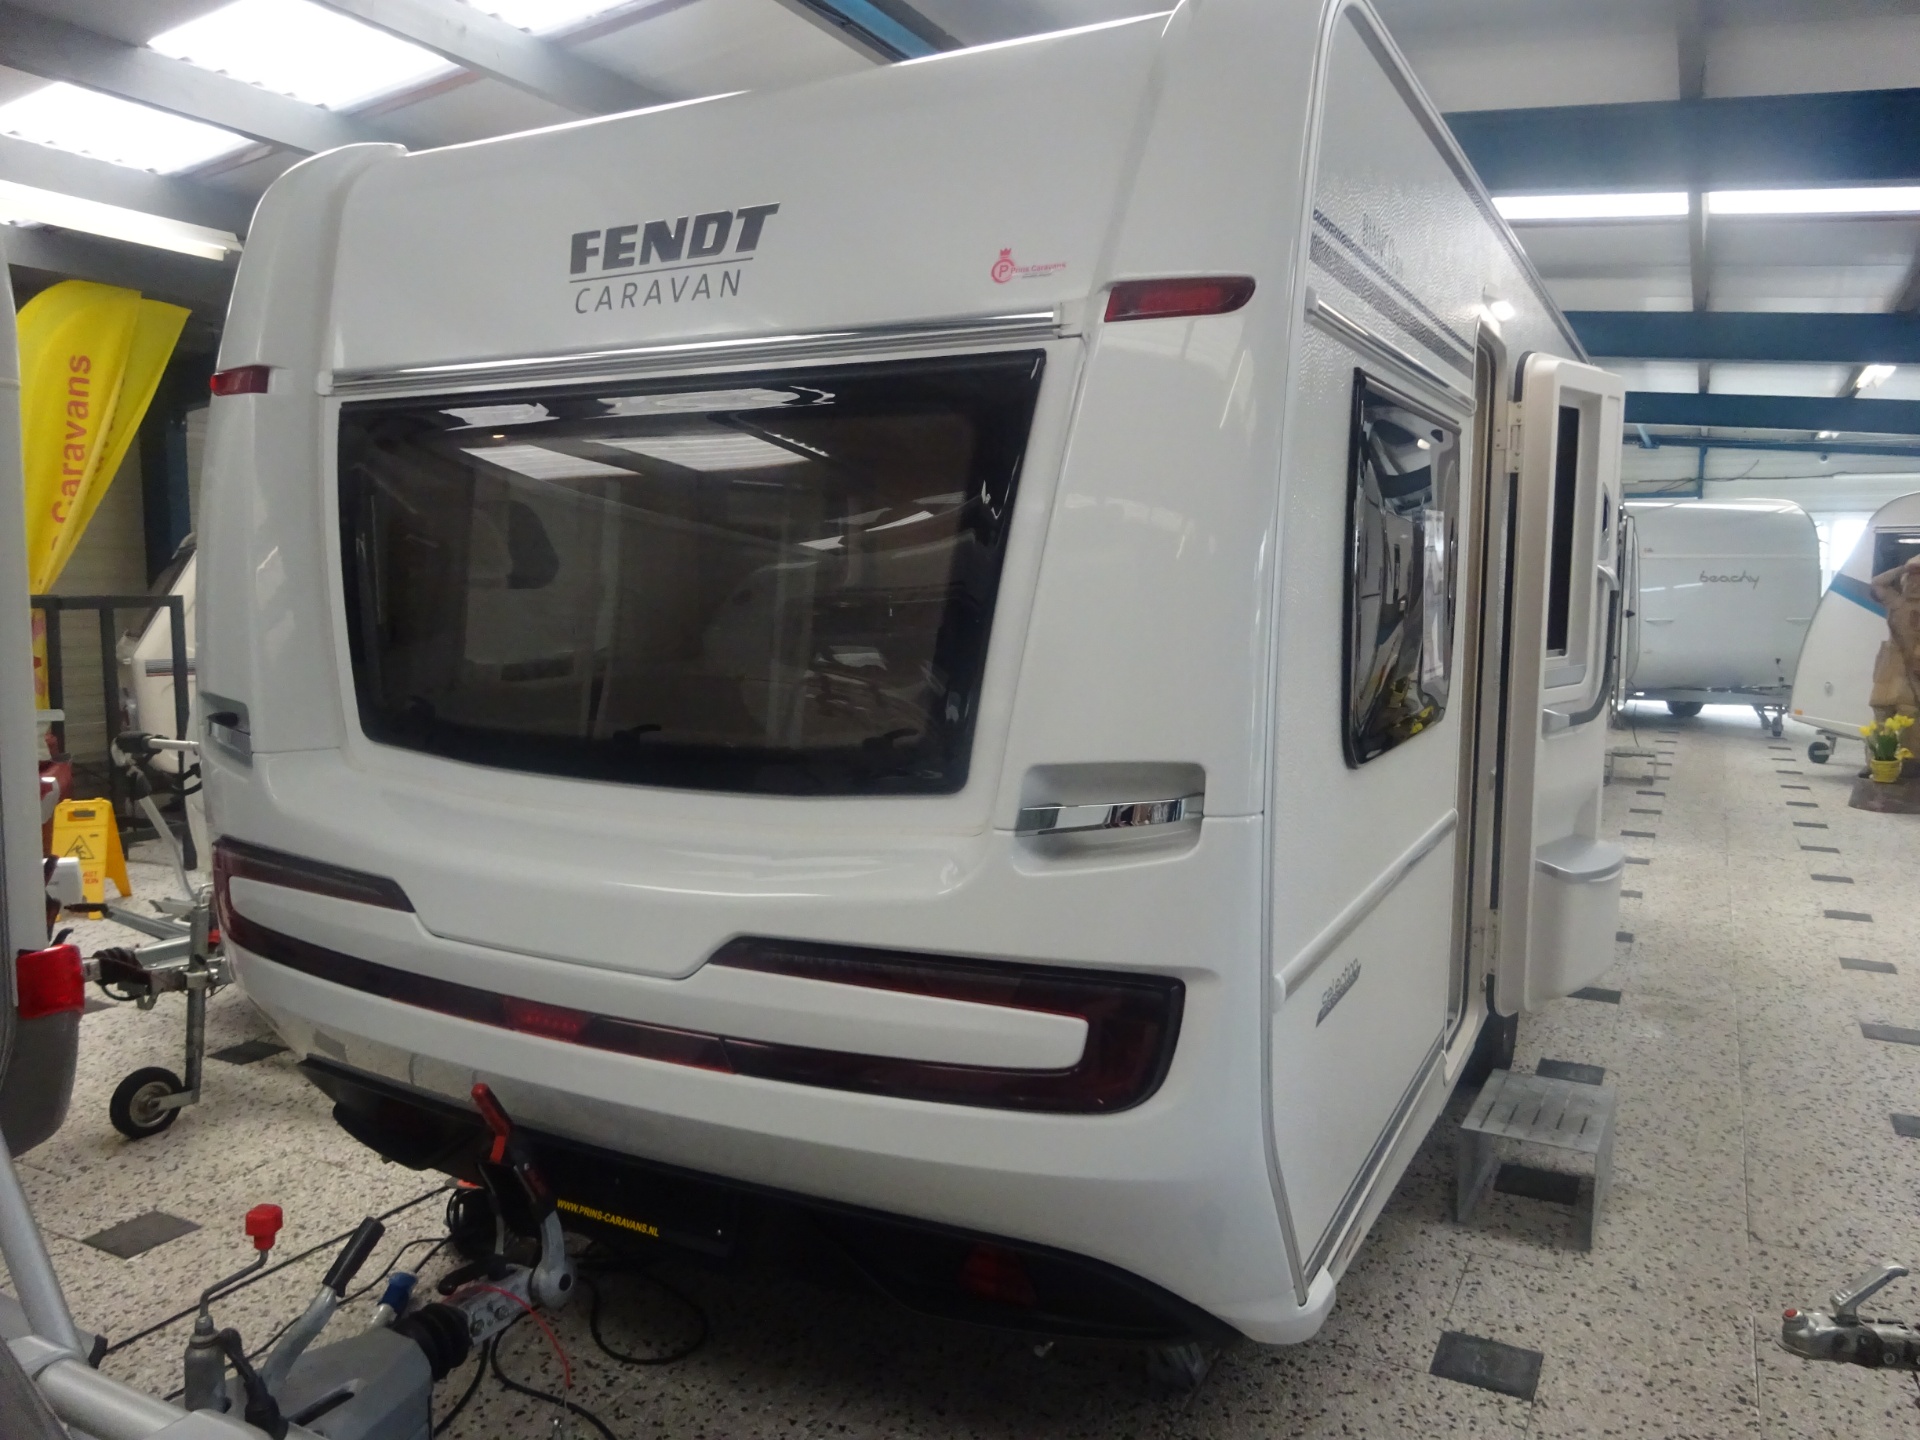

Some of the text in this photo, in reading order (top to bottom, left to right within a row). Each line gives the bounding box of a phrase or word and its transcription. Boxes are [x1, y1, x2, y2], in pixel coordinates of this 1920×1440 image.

[570, 202, 780, 275] FENDT
[575, 269, 741, 314] CARAVAN
[51, 354, 92, 524] Caravans
[1698, 570, 1760, 590] beachy
[556, 1198, 660, 1237] WWW.PRINS-CARAVANS.NL
